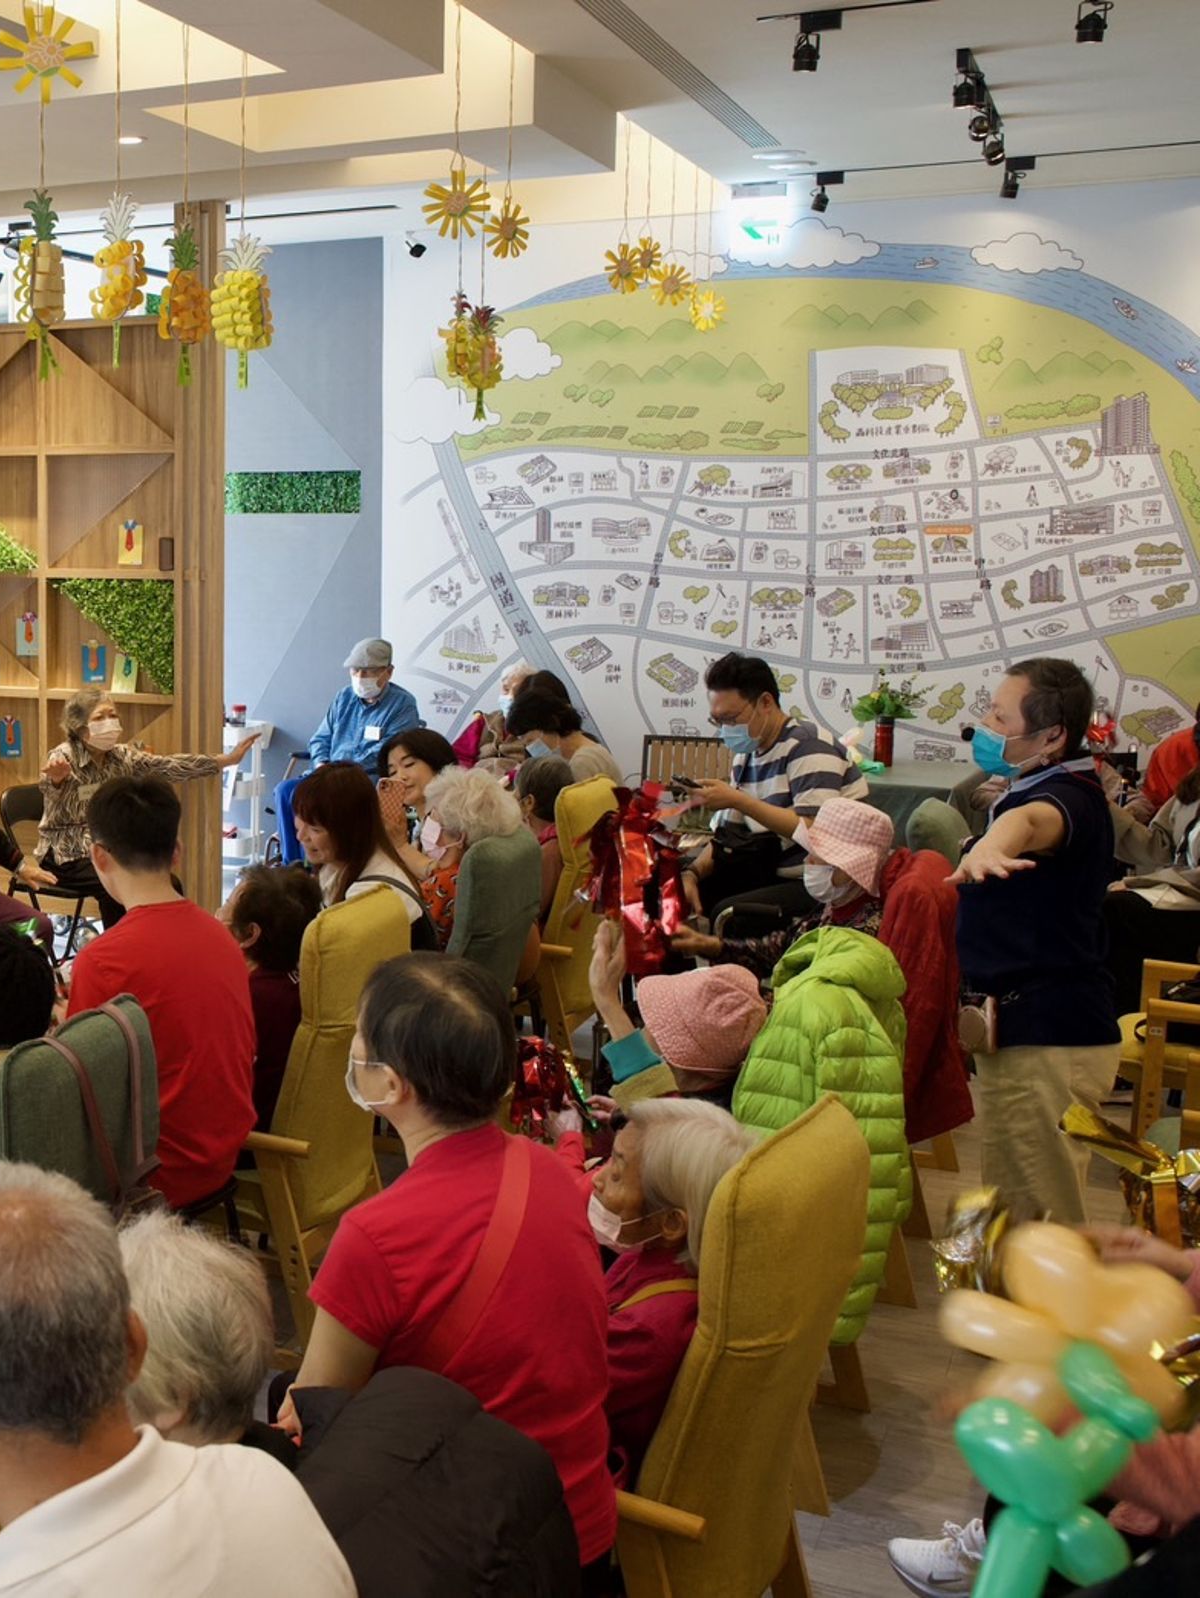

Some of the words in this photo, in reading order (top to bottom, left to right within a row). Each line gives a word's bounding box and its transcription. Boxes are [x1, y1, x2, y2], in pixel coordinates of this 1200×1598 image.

[872, 448, 910, 460] 文化北路
[490, 571, 532, 637] 國道一號
